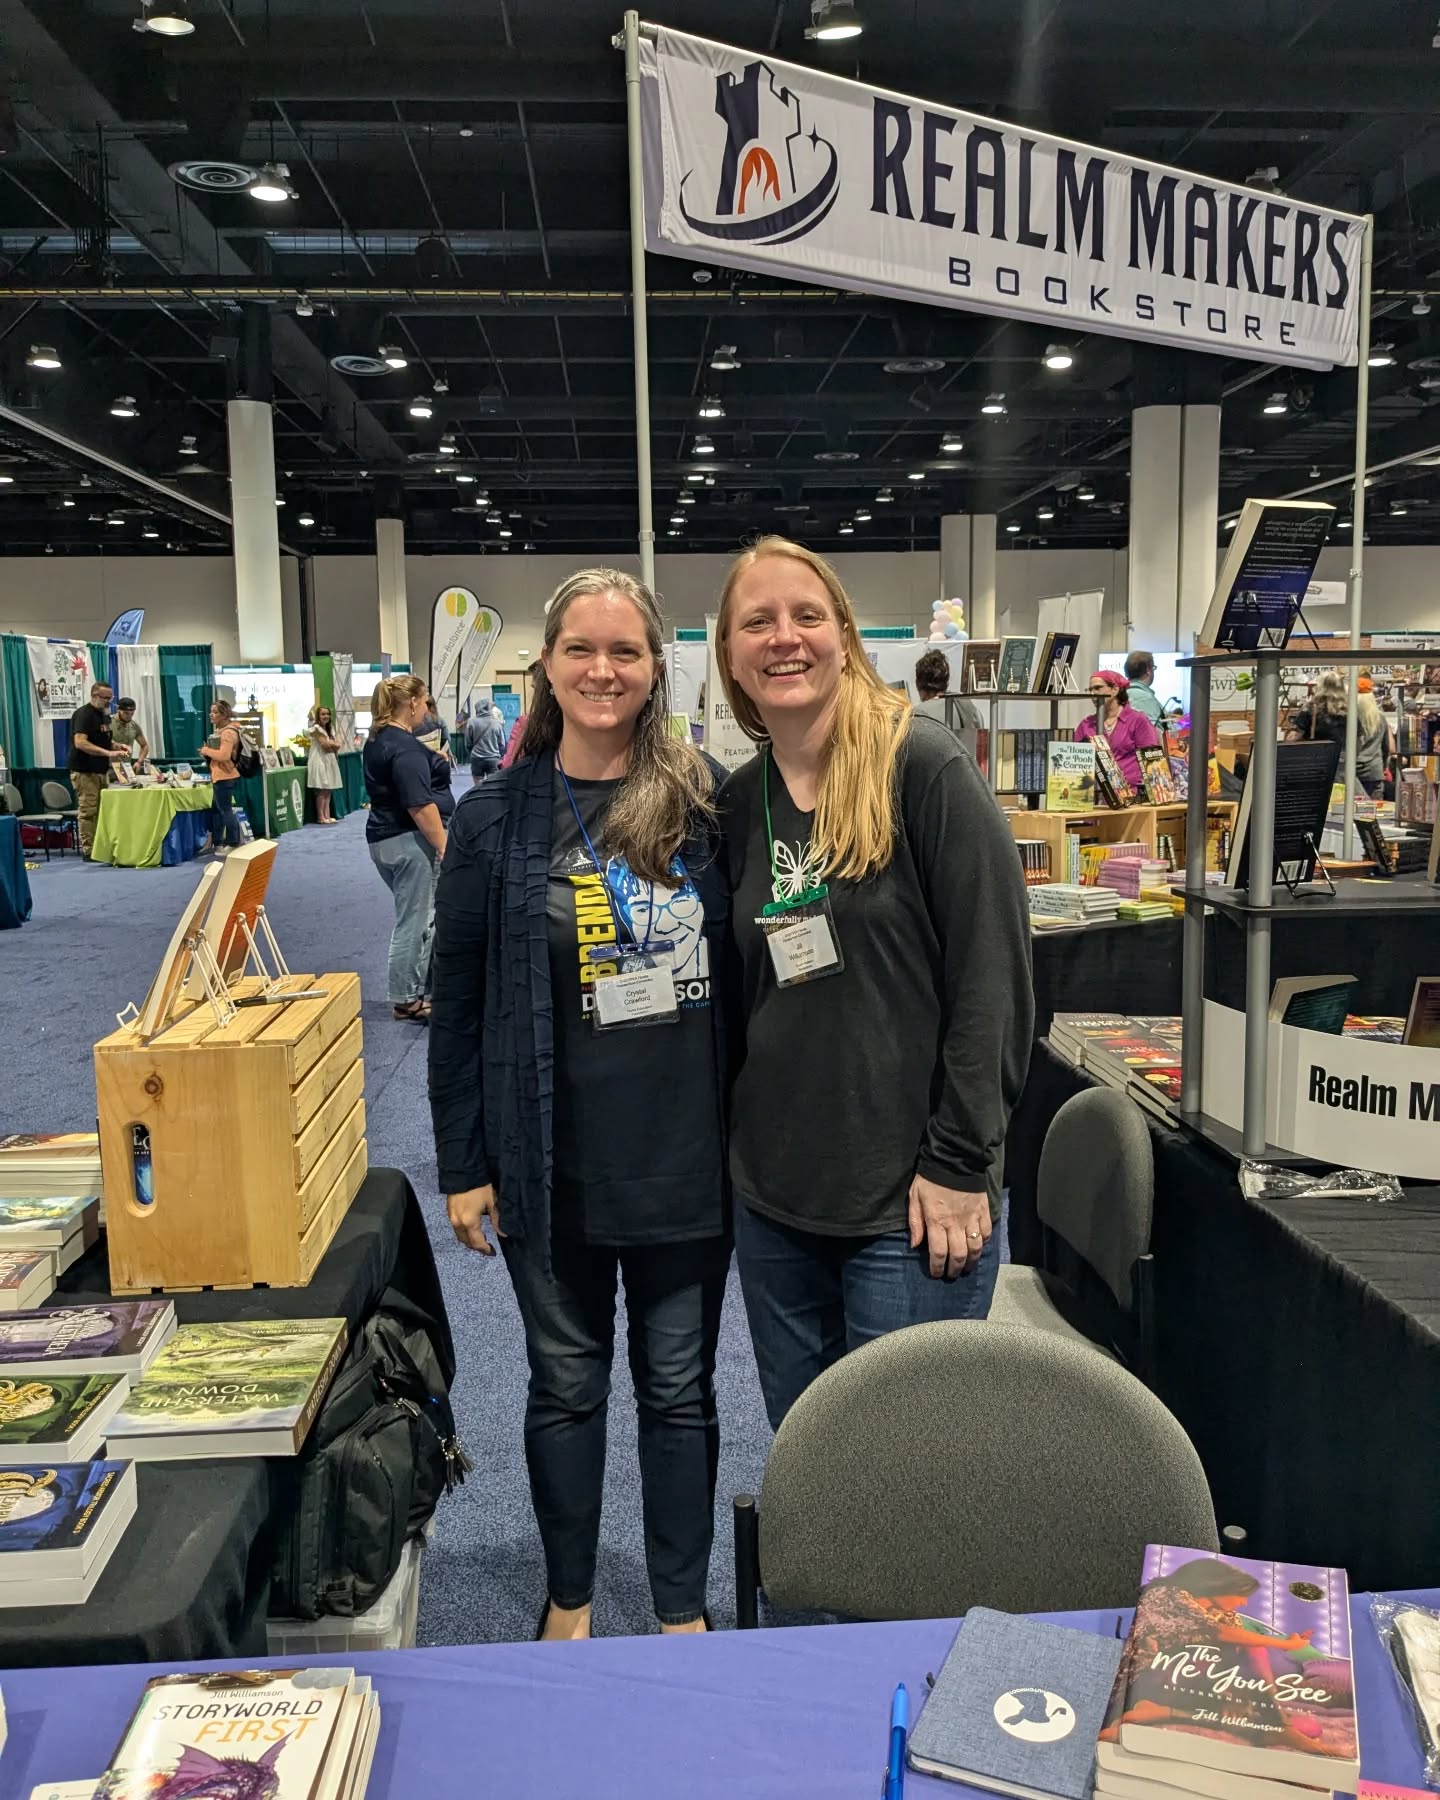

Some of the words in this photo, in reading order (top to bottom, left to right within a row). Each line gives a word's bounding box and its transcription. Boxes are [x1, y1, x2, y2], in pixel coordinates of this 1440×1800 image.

[870, 97, 1109, 262] REALM
[1128, 167, 1350, 310] MAKERS
[948, 256, 1297, 347] BOOKSTORE
[1068, 745, 1093, 755] House
[1063, 760, 1092, 770] Corner
[1072, 755, 1093, 764] Pooh
[755, 915, 801, 925] wonderfully
[624, 995, 651, 1006] Crawford
[626, 988, 647, 998] Crystal
[1309, 1064, 1397, 1118] Realm
[177, 1384, 258, 1396] DOWN
[139, 1393, 280, 1408] WATERSHIP
[1185, 1644, 1223, 1663] The
[1150, 1651, 1201, 1684] Me
[1206, 1663, 1275, 1694] You
[1274, 1673, 1332, 1703] See
[210, 1690, 228, 1699] Jill
[229, 1689, 284, 1698] Williamson
[152, 1700, 323, 1721] STORYWORLD
[1191, 1708, 1219, 1721] Jill
[1221, 1714, 1286, 1733] Williamson
[193, 1717, 320, 1743] FIRST
